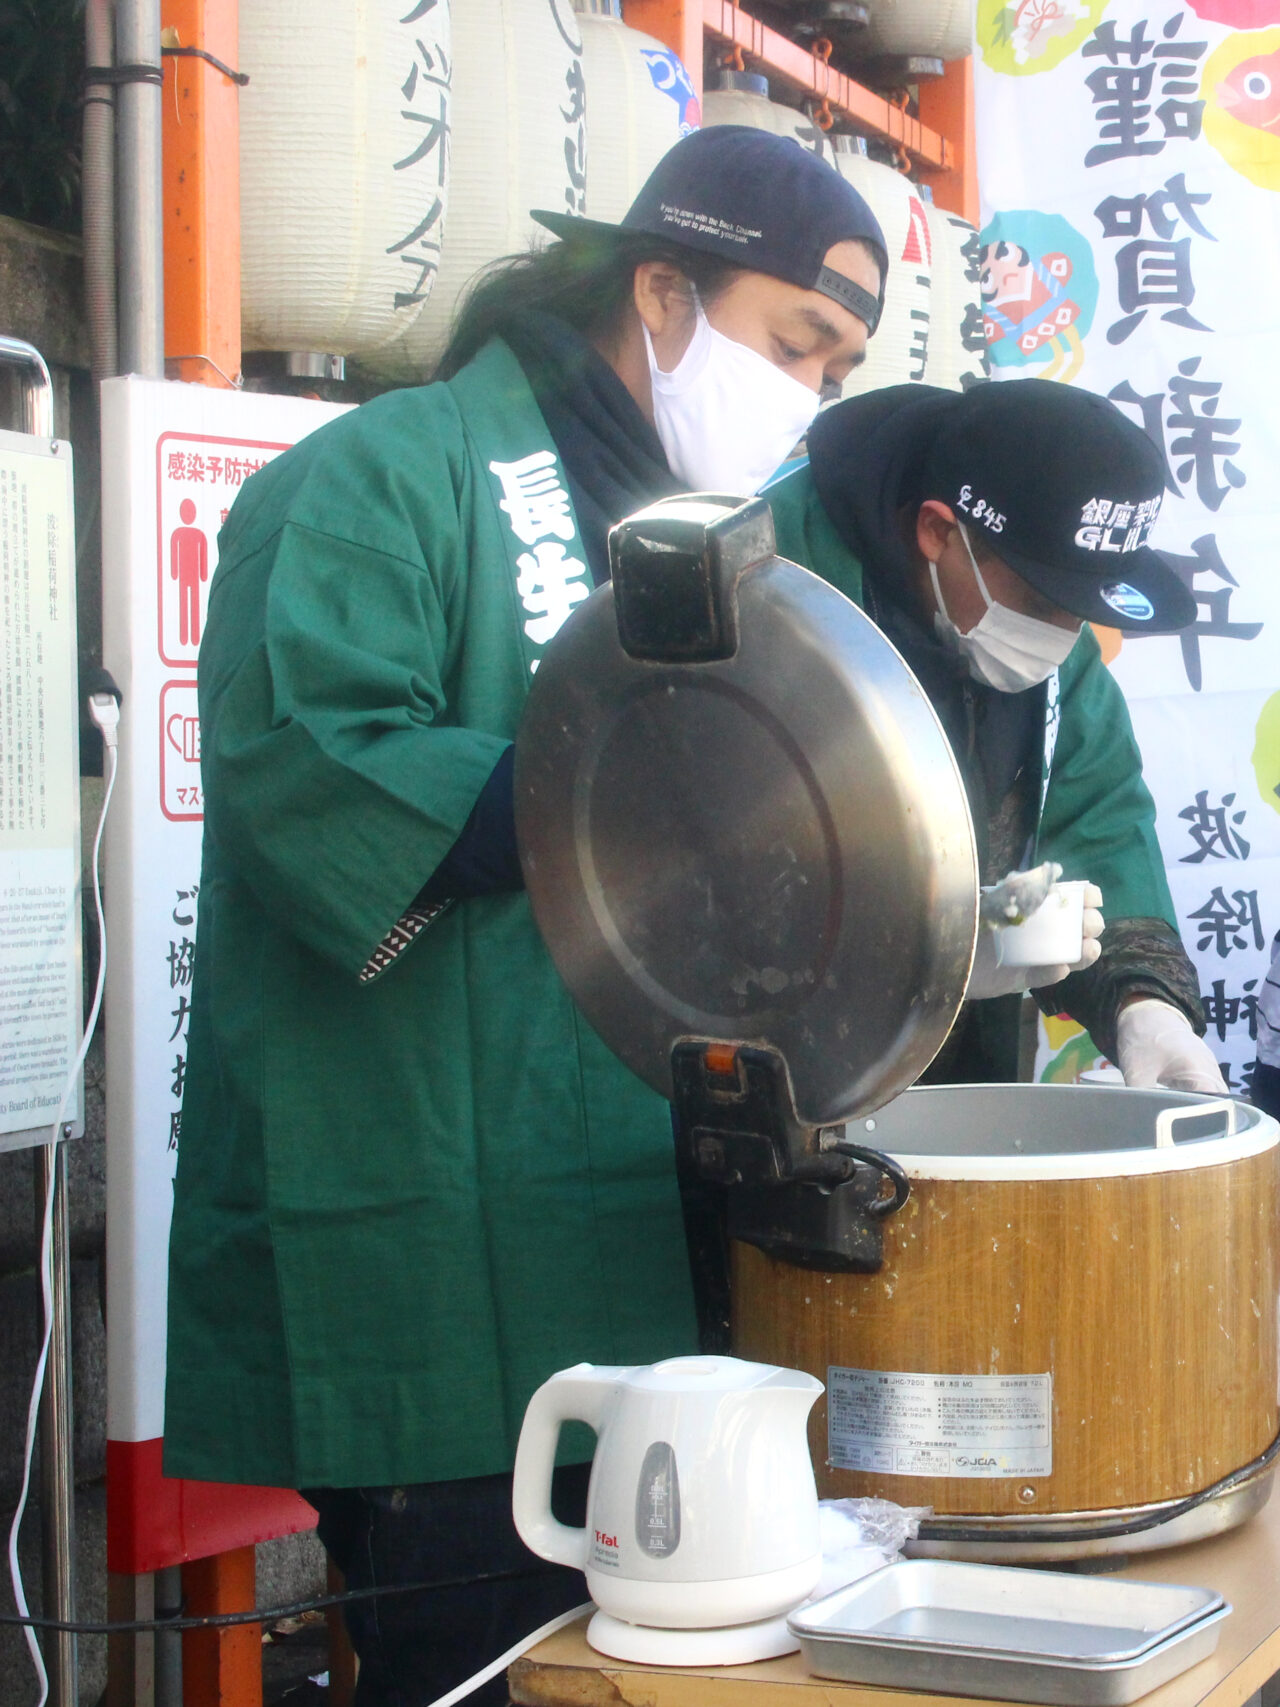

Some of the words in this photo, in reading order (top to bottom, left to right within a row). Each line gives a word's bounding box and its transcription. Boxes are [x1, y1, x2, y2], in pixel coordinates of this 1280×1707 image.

[691, 221, 699, 229] to
[695, 213, 708, 222] with
[709, 217, 719, 226] the
[167, 451, 268, 486] 感染予防対
[47, 513, 58, 621] 波除稲荷神社
[489, 450, 590, 675] 長生
[176, 786, 204, 808] マス
[9, 1098, 28, 1112] Board
[29, 1097, 36, 1109] of
[37, 1093, 62, 1107] Educati
[595, 1530, 619, 1548] T-fal
